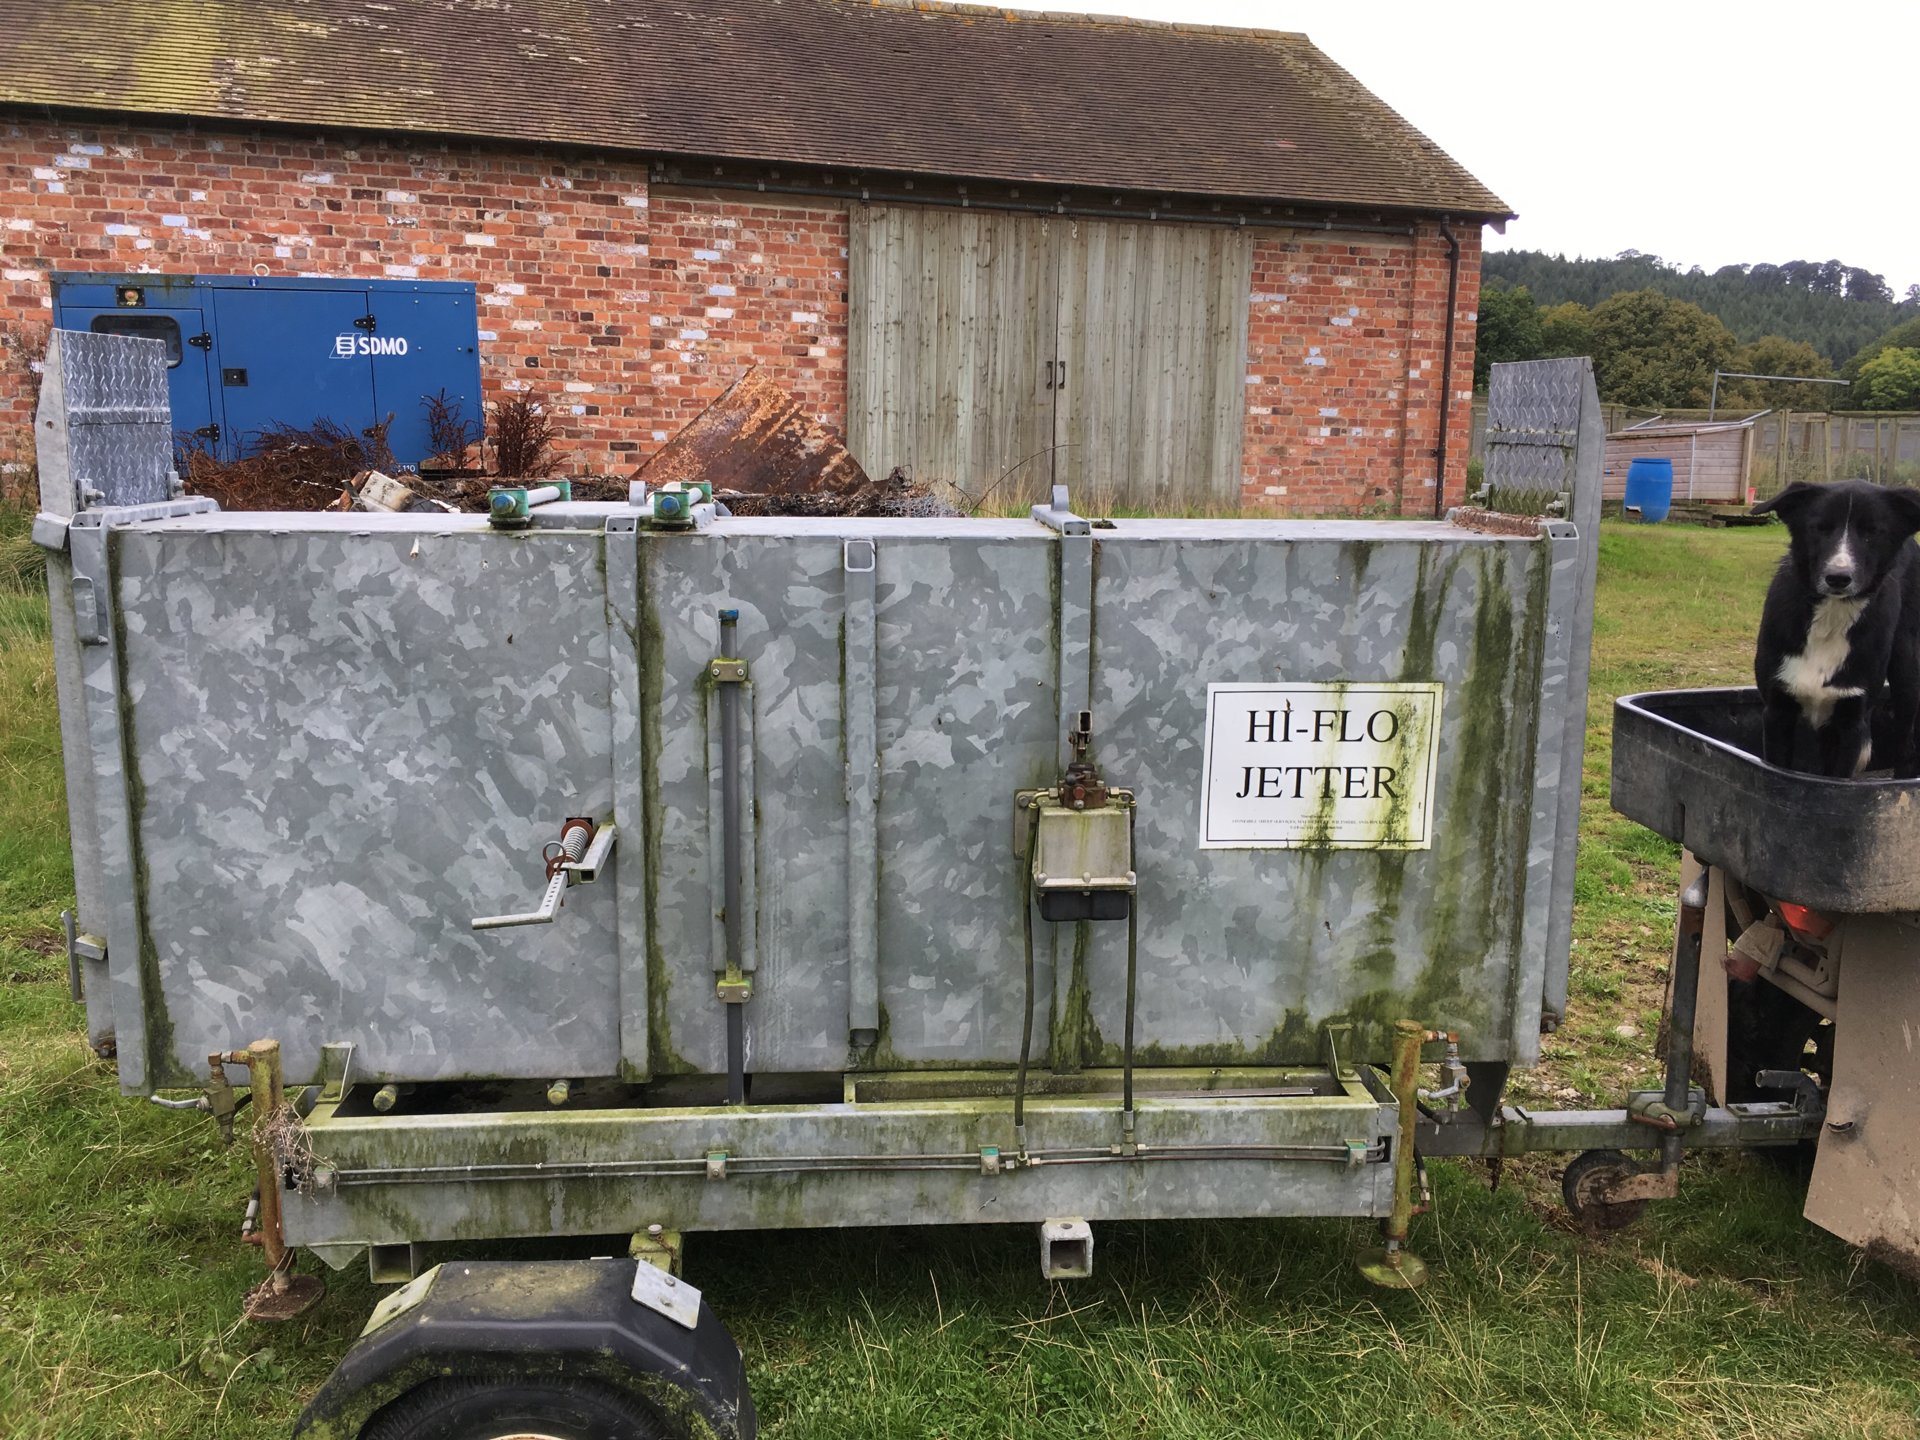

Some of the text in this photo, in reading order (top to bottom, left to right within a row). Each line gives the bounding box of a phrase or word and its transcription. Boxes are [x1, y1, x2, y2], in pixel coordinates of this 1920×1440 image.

[359, 336, 408, 356] SDMO
[1246, 709, 1399, 743] HI-FLO
[1235, 766, 1400, 799] JETTER
